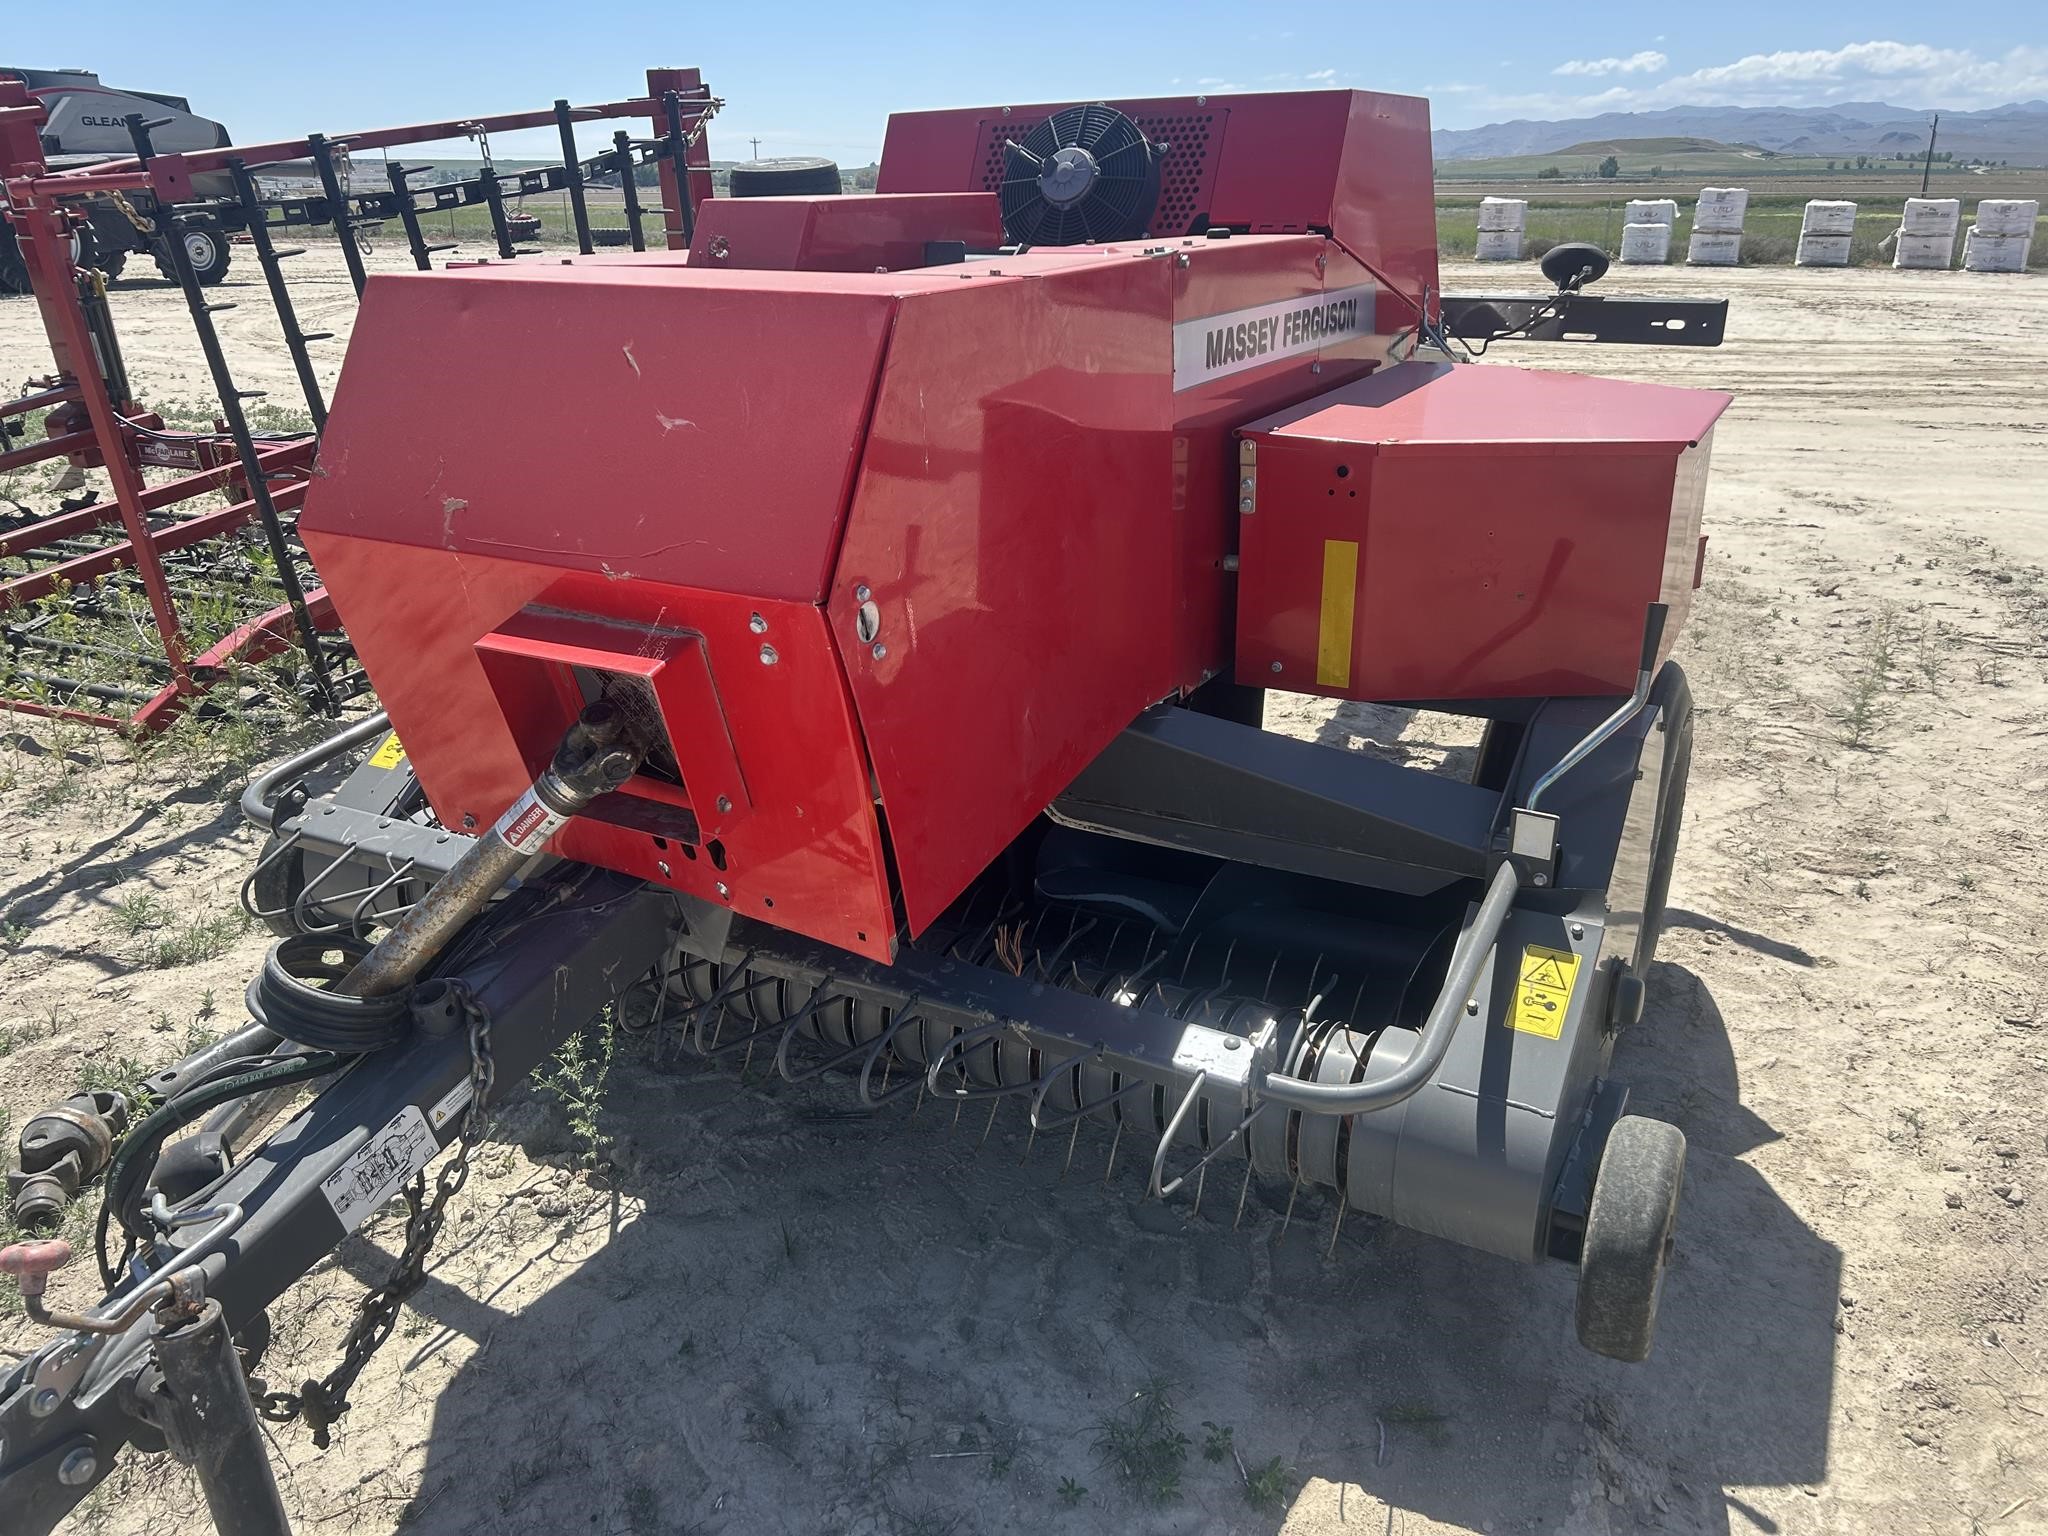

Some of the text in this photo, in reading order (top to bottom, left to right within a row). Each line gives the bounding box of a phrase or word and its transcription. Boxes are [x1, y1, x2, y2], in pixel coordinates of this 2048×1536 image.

[1205, 298, 1357, 369] MASSEY FERGUSON
[516, 807, 543, 834] DANGER
